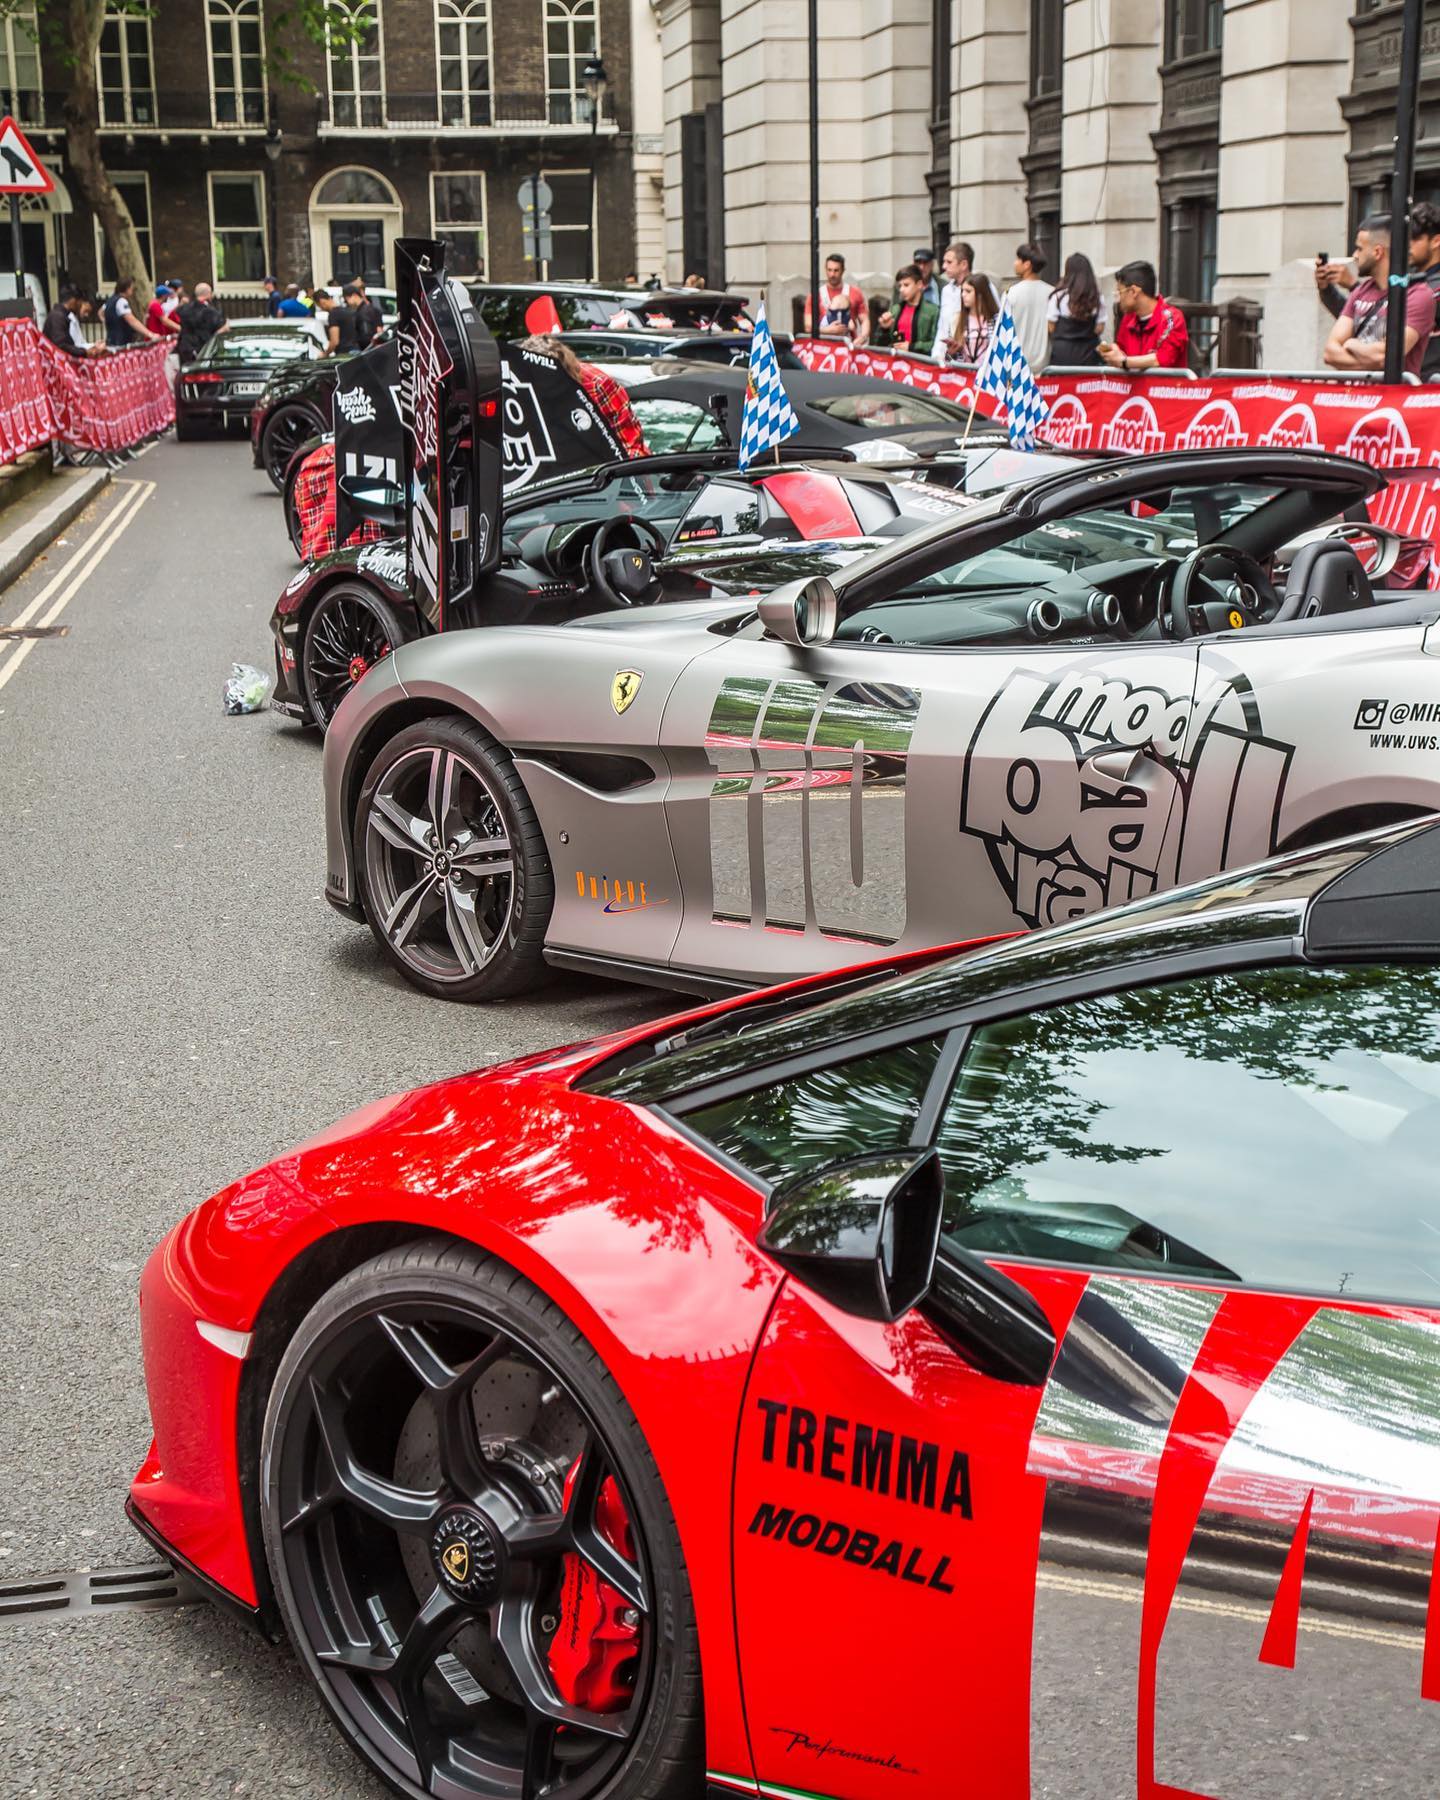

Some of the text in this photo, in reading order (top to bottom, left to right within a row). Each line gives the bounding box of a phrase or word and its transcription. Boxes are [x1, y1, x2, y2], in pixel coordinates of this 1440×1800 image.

[757, 1398, 973, 1521] TREMMA
[747, 1503, 955, 1595] MODBALL
[770, 1727, 920, 1775] Performante
